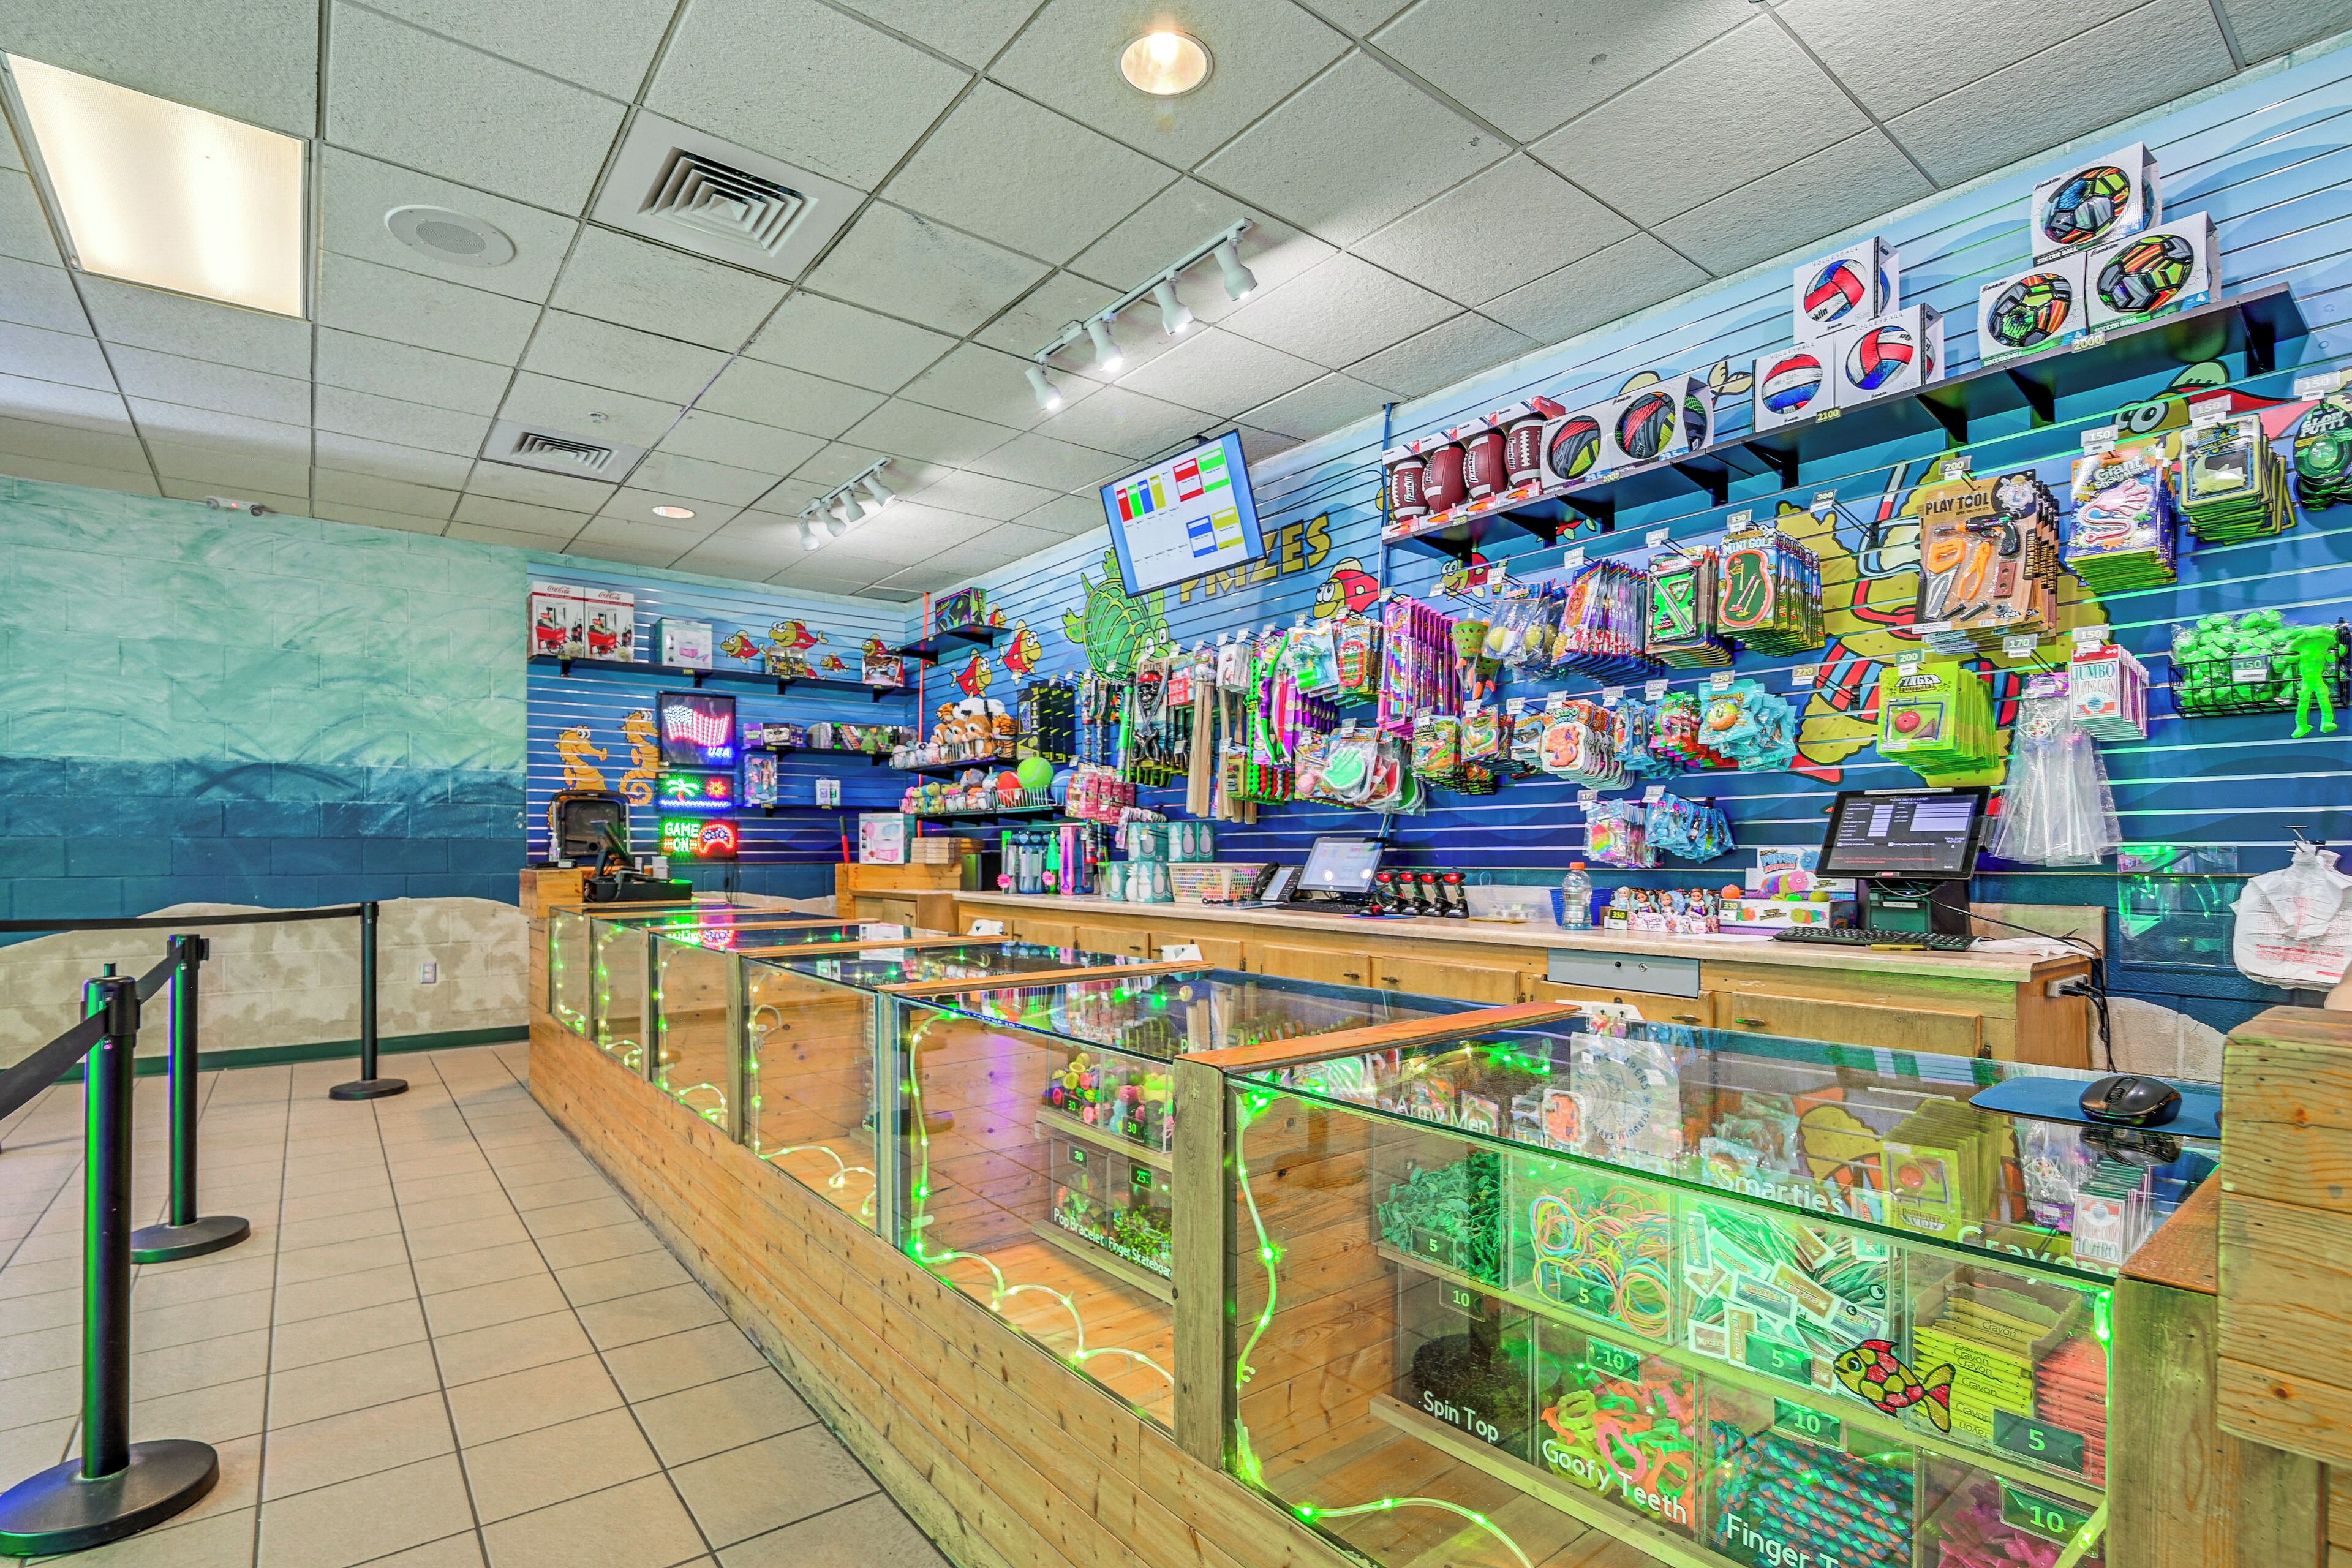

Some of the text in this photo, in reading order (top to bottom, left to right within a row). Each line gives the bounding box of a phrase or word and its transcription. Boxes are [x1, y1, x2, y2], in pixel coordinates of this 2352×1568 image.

[2037, 246, 2078, 265] SOCCER BALL
[2094, 317, 2138, 334] SOCCER BALL
[2073, 334, 2104, 350] 2000
[1983, 351, 2024, 368] SOCCER BALL
[2304, 377, 2331, 390] 150
[1817, 409, 1840, 421] 2100
[2197, 401, 2222, 415] 150
[2299, 416, 2348, 437] PUTTY
[2089, 430, 2111, 442] 150
[1945, 461, 1965, 471] 200
[2094, 454, 2144, 482] Giant
[1815, 492, 1834, 502] 300
[1925, 492, 1989, 515] PLAY TOOL
[1730, 513, 1747, 524] 330
[1722, 537, 1775, 556] MINI GOLF
[2010, 638, 2030, 648] 170
[2080, 630, 2103, 640] 150
[1899, 652, 1918, 662] 200
[2237, 660, 2262, 669] 150
[1896, 674, 1942, 688] FINGER
[2073, 663, 2116, 682] JUMBO
[1899, 684, 1937, 693] FOOTBALL
[707, 747, 732, 758] USA
[664, 821, 700, 837] GAME
[673, 838, 689, 852] ON
[1762, 853, 1798, 867] PUFFER
[1610, 911, 1626, 920] 350
[1068, 1100, 1076, 1111] 30
[1396, 1095, 1490, 1134] Army Men
[1127, 1122, 1137, 1134] 30
[1074, 1150, 1084, 1162] 30
[1717, 1163, 1845, 1216] Smarties
[1053, 1207, 1106, 1247] Pop Bracelet
[1428, 1238, 1438, 1253] 5
[1108, 1236, 1172, 1280] Finger Skateboar
[1452, 1290, 1470, 1308] 10
[1578, 1287, 1589, 1305] 5
[1981, 1321, 2016, 1339] Crayon
[1603, 1349, 1626, 1370] 10
[1771, 1349, 1785, 1368] 5
[1953, 1348, 1989, 1366] Crayon
[1957, 1357, 1992, 1376] Crayon
[1961, 1377, 1997, 1397] Crayon
[1422, 1390, 1499, 1443] Spin Top
[1955, 1403, 1991, 1422] Crayon
[1793, 1410, 1821, 1434] 10
[1959, 1421, 1988, 1438] rayon
[2028, 1428, 2046, 1452] 5
[1541, 1439, 1687, 1525] Goofy Teeth
[2029, 1505, 2065, 1534] 10
[1726, 1513, 1811, 1568] Finger
